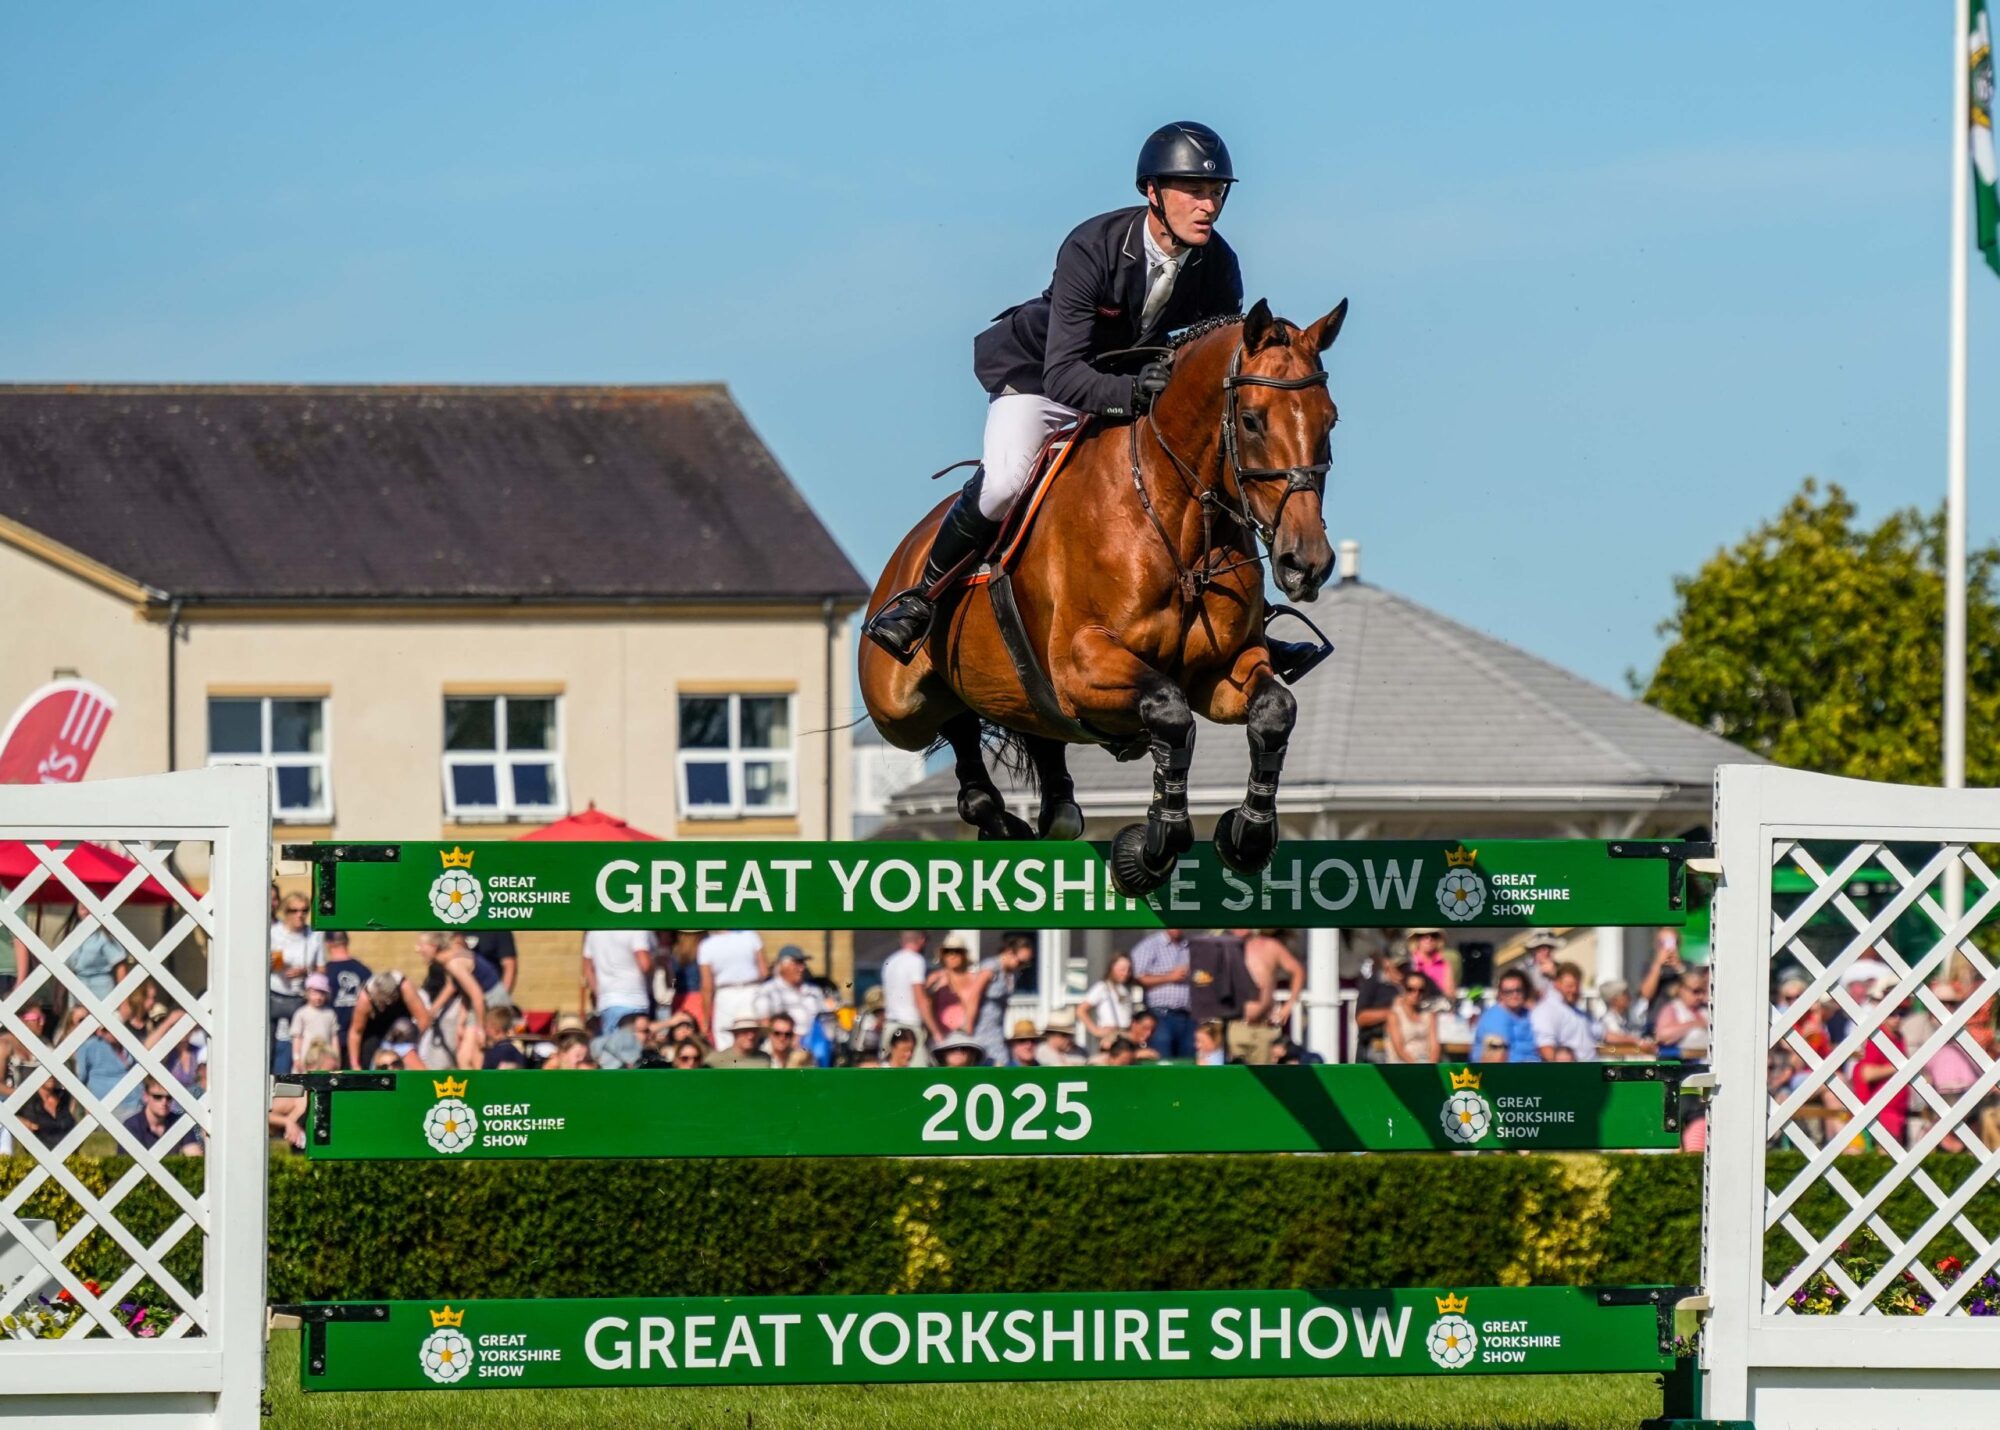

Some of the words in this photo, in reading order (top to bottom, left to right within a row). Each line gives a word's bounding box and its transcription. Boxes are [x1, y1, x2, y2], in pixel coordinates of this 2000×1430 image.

[489, 876, 536, 888] GREAT
[1492, 874, 1536, 885] GREAT
[596, 860, 812, 913] GREAT
[828, 859, 1200, 912] YORKSHIE
[488, 892, 570, 903] YORKSHIRE
[1493, 889, 1570, 900] YORKSHIRE
[488, 907, 533, 918] SHOW
[1493, 904, 1535, 915] SHOW
[1497, 1097, 1541, 1107] GREAT
[483, 1104, 530, 1116] GREAT
[922, 1081, 1092, 1141] 2025
[1497, 1112, 1574, 1122] YORKSHIRE
[483, 1118, 565, 1131] YORKSHIRE
[1497, 1127, 1539, 1137] SHOW
[483, 1135, 528, 1147] SHOW
[1483, 1321, 1528, 1332] GREAT
[479, 1334, 527, 1346] GREAT
[585, 1314, 801, 1370] GREAT
[817, 1309, 1190, 1365] YORKSHIRE
[1211, 1306, 1412, 1360] SHOW
[1483, 1336, 1560, 1347] YORKSHIRE
[479, 1350, 561, 1362] YORKSHIRE
[1483, 1351, 1526, 1363] SHOW
[479, 1365, 524, 1377] SHOW
